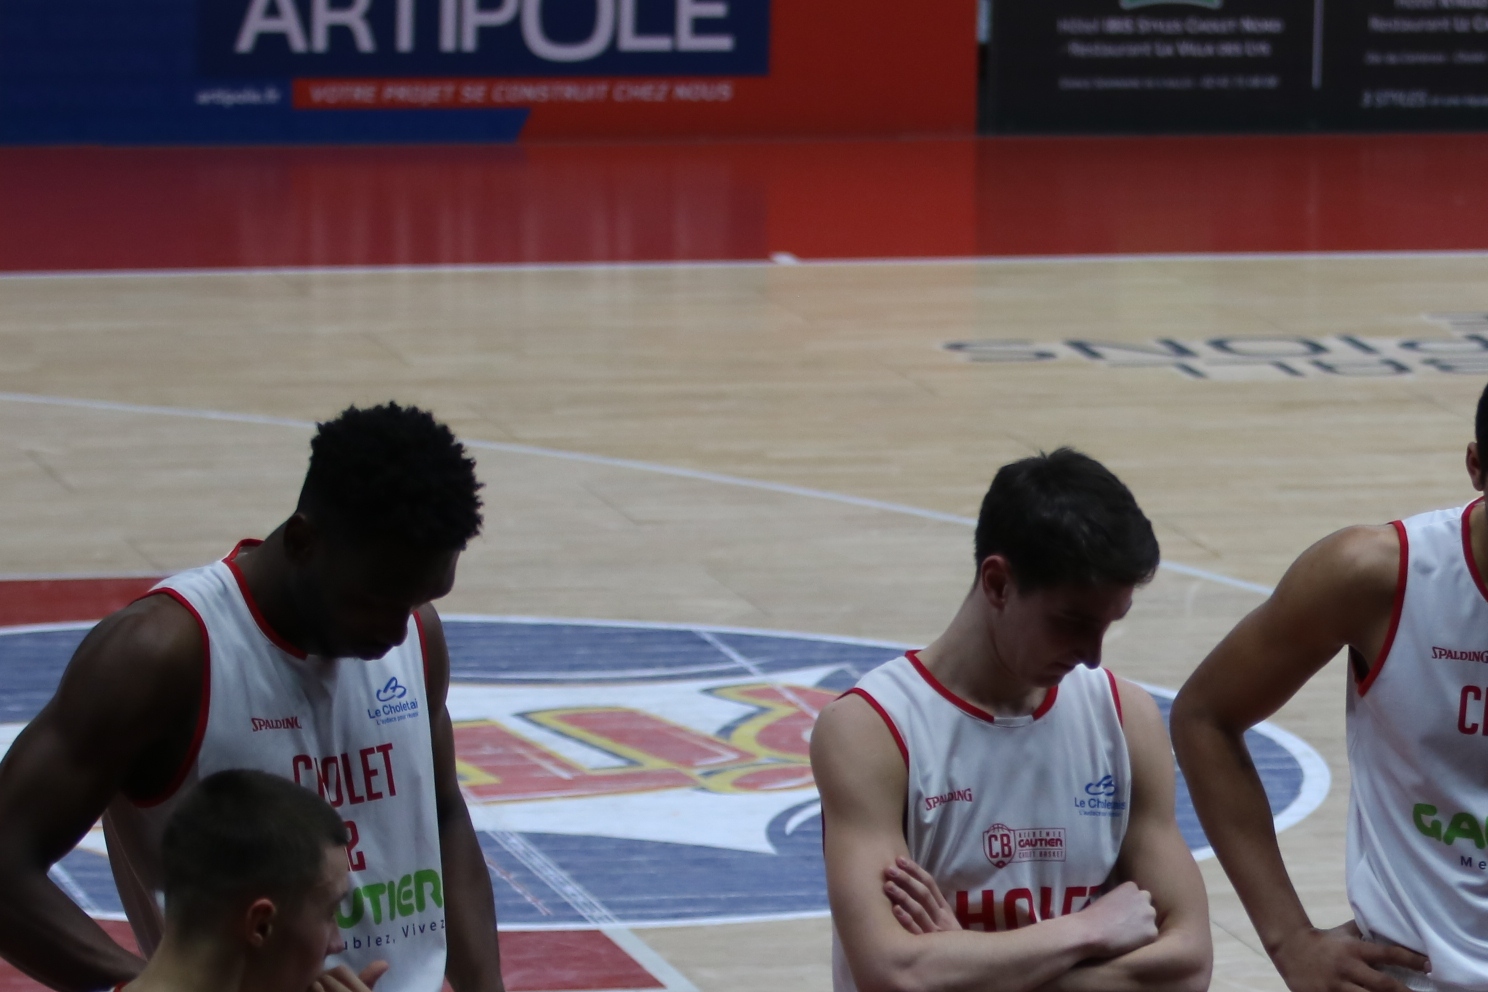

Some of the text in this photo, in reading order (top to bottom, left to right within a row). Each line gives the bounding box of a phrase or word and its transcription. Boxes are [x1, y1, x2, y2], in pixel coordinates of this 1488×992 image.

[1367, 14, 1450, 33] Restaurant
[309, 80, 734, 106] VOTRE PROJET SE CONSTRUIT CHEZ NOUS
[367, 697, 419, 719] Le Choletai
[292, 743, 396, 809] COLET
[924, 788, 973, 811] SPALDING
[1074, 797, 1086, 808] Le
[988, 833, 1012, 859] CB
[1018, 838, 1063, 848] GAUTIER
[334, 868, 444, 929] UTIER
[401, 918, 445, 938] Vivez
